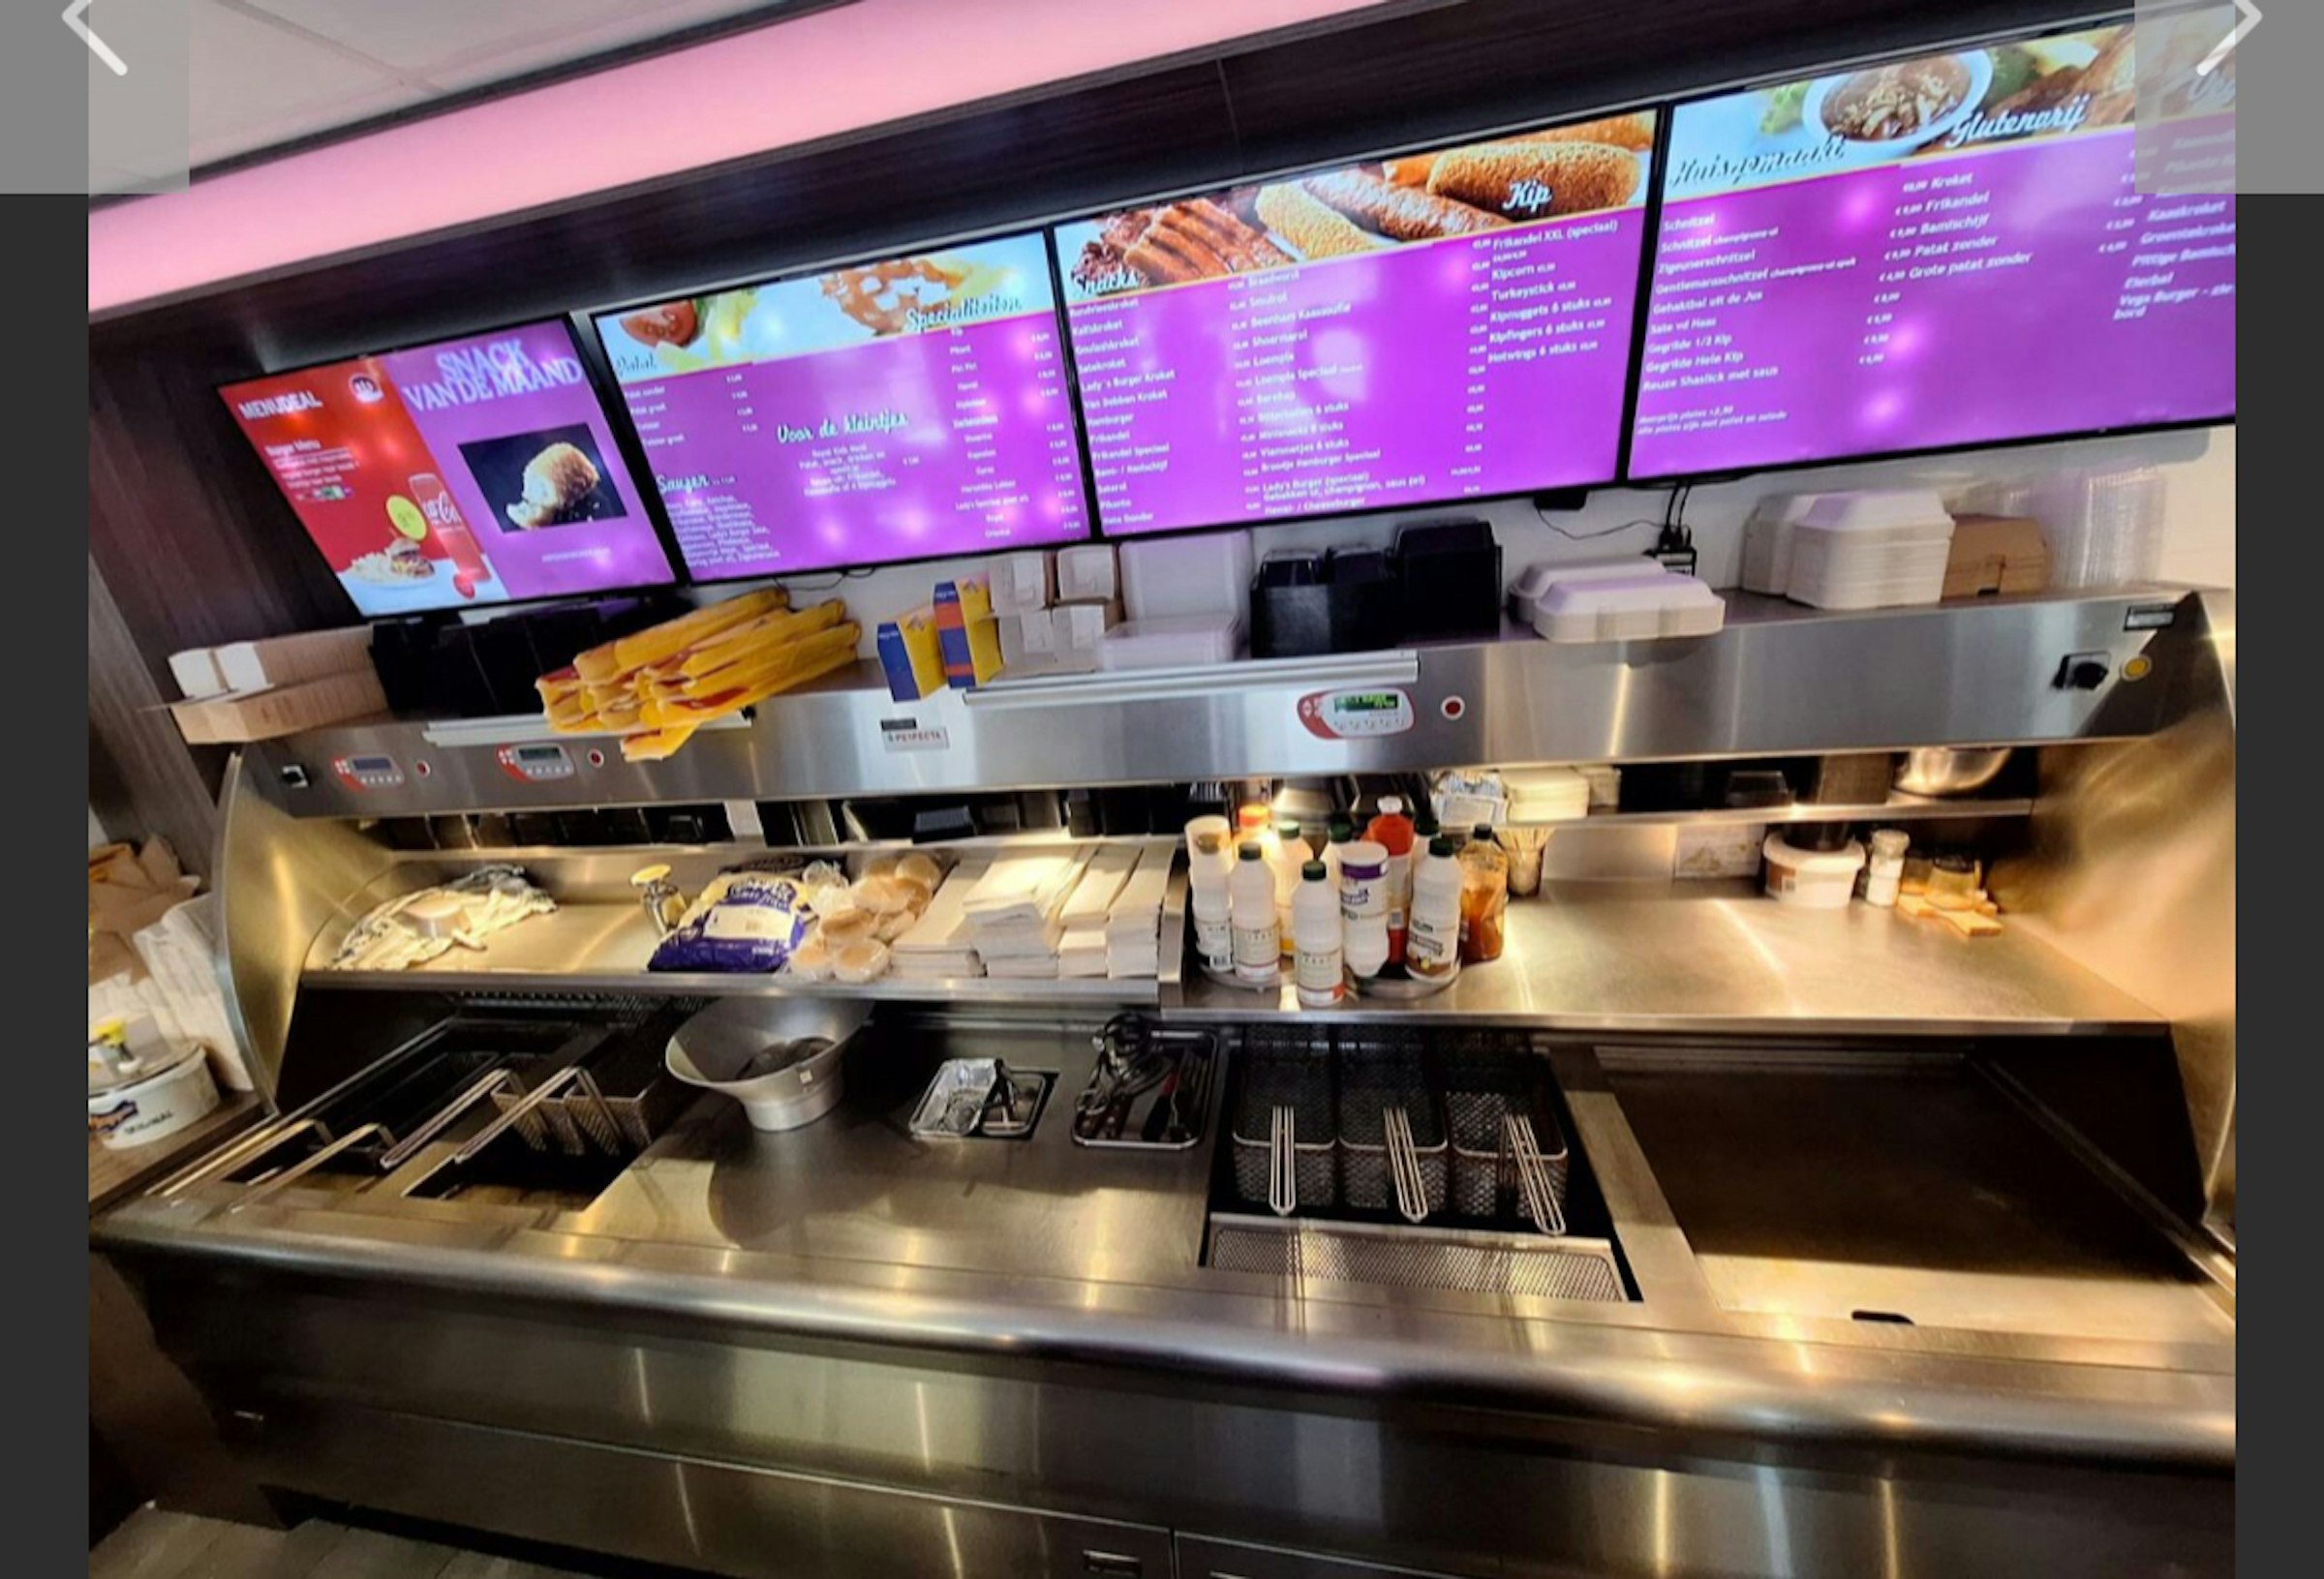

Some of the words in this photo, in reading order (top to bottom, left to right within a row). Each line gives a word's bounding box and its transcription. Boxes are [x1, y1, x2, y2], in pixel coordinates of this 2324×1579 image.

[1931, 172, 1973, 190] Kroket
[1502, 178, 1552, 213] Kip
[1925, 191, 1990, 213] Frikandel
[1663, 213, 1716, 232] Schnitzel
[1492, 231, 1543, 252] Frikandel
[1544, 228, 1564, 242] XXL
[2140, 222, 2236, 245] Groentekroke
[1661, 234, 1712, 254] Schnitzel
[1913, 242, 1950, 258] Patat
[1951, 235, 2000, 253] zonder
[2180, 242, 2236, 261] Bamisch
[1491, 264, 1535, 282] Kipcorn
[1909, 262, 1946, 279] Grote
[1948, 258, 1985, 277] patat
[1986, 252, 2034, 269] zonder
[1492, 281, 1554, 302] Turkeystick
[1489, 304, 1549, 322] Kipnuggets
[1562, 297, 1591, 313] stuks
[1653, 296, 1707, 316] Gehaktbal
[1727, 292, 1742, 305] de
[1488, 325, 1544, 345] Kipfingers
[1555, 319, 1585, 334] stuks
[1691, 317, 1717, 330] Haas
[1714, 333, 1733, 348] Kip
[437, 339, 529, 383] SNACK
[1253, 351, 1296, 367] Loempia
[1487, 348, 1537, 364] Hotwings
[1548, 342, 1578, 355] stuks
[1725, 350, 1745, 365] Kip
[403, 380, 459, 411] VAN
[459, 375, 494, 403] DE
[493, 356, 584, 398] MAAND
[1113, 374, 1144, 388] Burger
[1145, 369, 1176, 382] Kroket
[1255, 370, 1296, 386] Loempia
[1728, 368, 1751, 381] met
[1753, 366, 1779, 379] saus
[238, 390, 323, 419] MENUDEAL
[1138, 389, 1168, 402] Kroket
[777, 424, 814, 444] Voor
[819, 418, 839, 438] de
[1089, 431, 1131, 444] Frikandel
[1091, 447, 1133, 462] Frikandel
